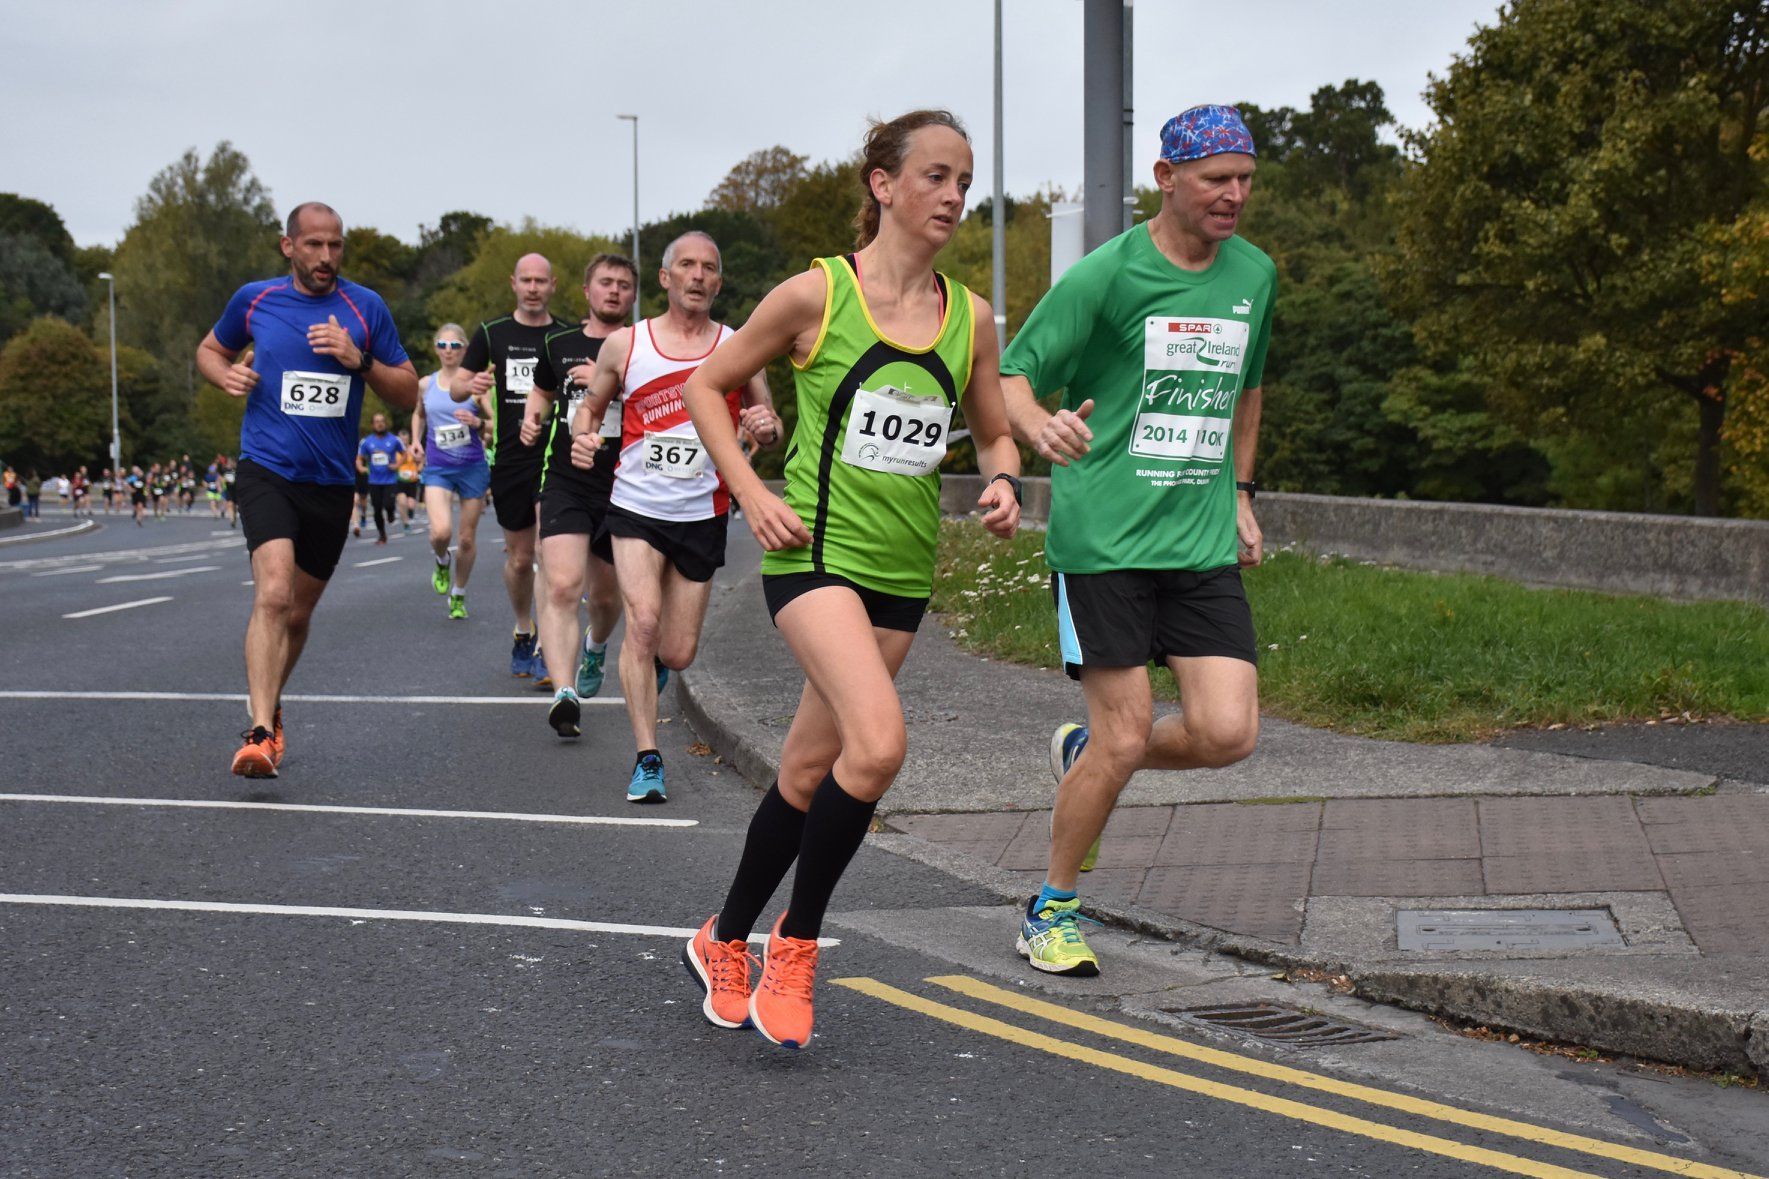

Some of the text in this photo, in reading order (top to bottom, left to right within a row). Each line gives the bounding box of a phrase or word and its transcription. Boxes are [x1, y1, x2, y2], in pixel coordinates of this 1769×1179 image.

[1179, 323, 1212, 332] SPAR
[1166, 340, 1240, 357] great Ireland
[290, 384, 340, 405] 628
[1145, 374, 1235, 410] Finisher
[284, 402, 304, 411] DNG
[642, 398, 685, 426] RUNNIN
[859, 410, 942, 447] 1029
[1142, 425, 1224, 446] 2014 10K
[649, 444, 698, 466] 367
[882, 455, 928, 468] myrunresults
[645, 461, 663, 471] DNG
[1136, 469, 1175, 478] RUNNING
